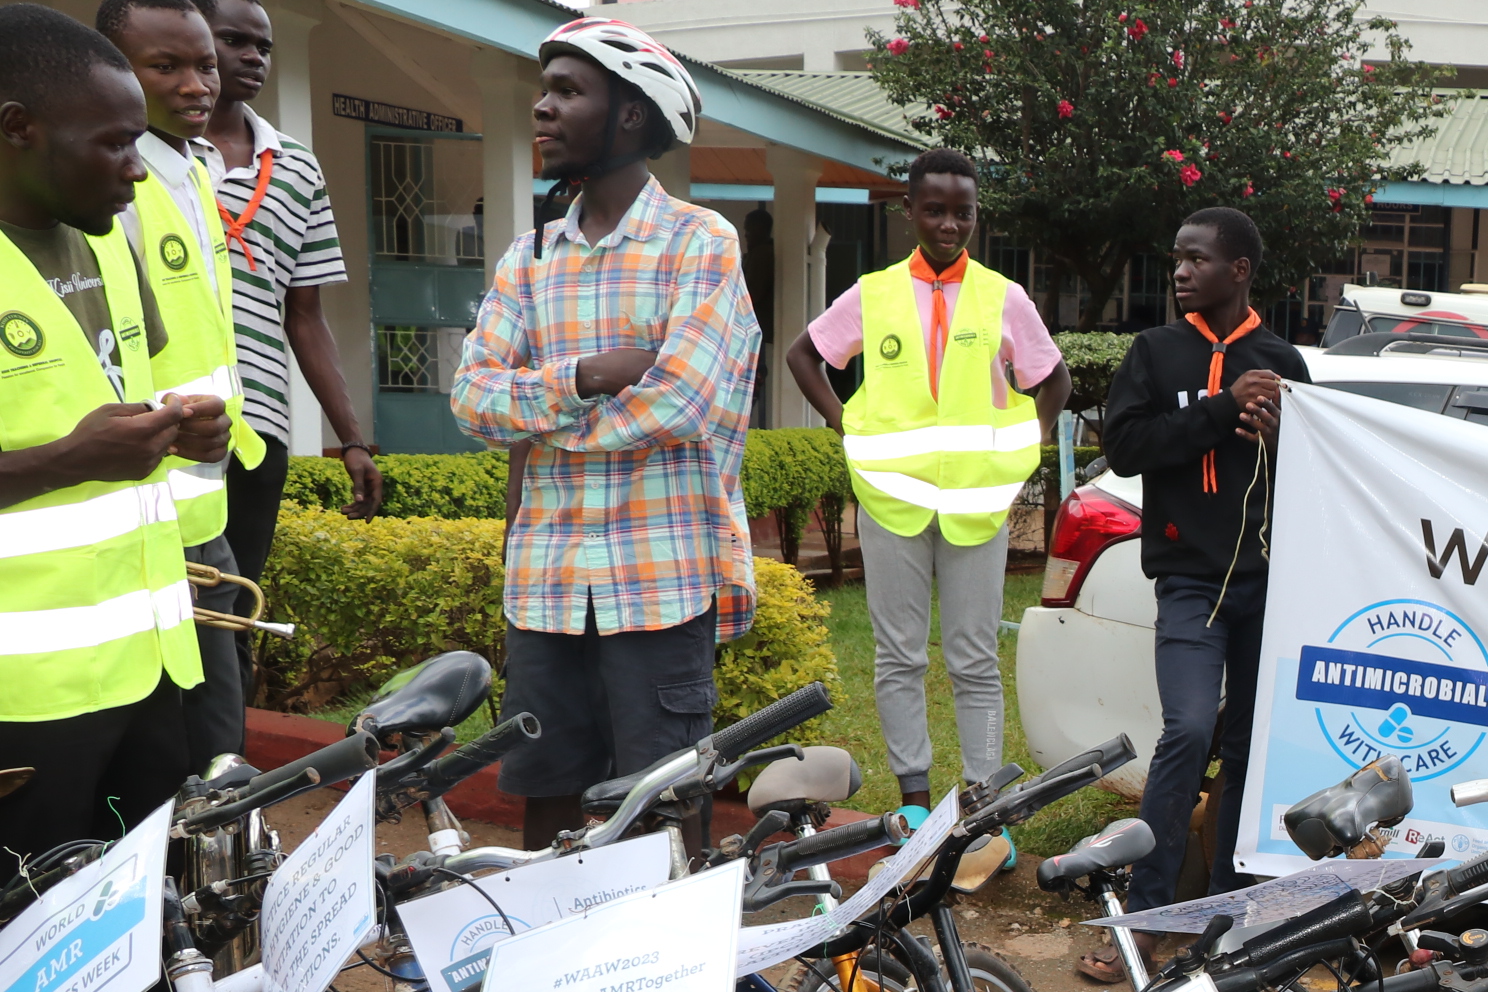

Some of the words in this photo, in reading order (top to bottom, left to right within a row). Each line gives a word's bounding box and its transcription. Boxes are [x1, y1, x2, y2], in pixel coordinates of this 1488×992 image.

[334, 97, 365, 118] HEALTH
[369, 102, 427, 129] ADMINISTRATIVE
[430, 114, 456, 132] OFFICER
[1367, 609, 1462, 648] HANDLE
[1338, 723, 1386, 764] WIT
[1401, 740, 1458, 773] CARE
[291, 814, 352, 888] REGULAR
[269, 881, 310, 955] HYGIENE
[312, 872, 321, 888] &
[324, 823, 364, 875] GOOD
[318, 877, 337, 905] TO
[35, 903, 85, 952] WORLD
[290, 938, 310, 978] THE
[310, 881, 357, 946] SPREAD
[461, 919, 508, 946] HANDLE
[81, 946, 121, 989] WEEK
[553, 951, 660, 989] #WAAW2023
